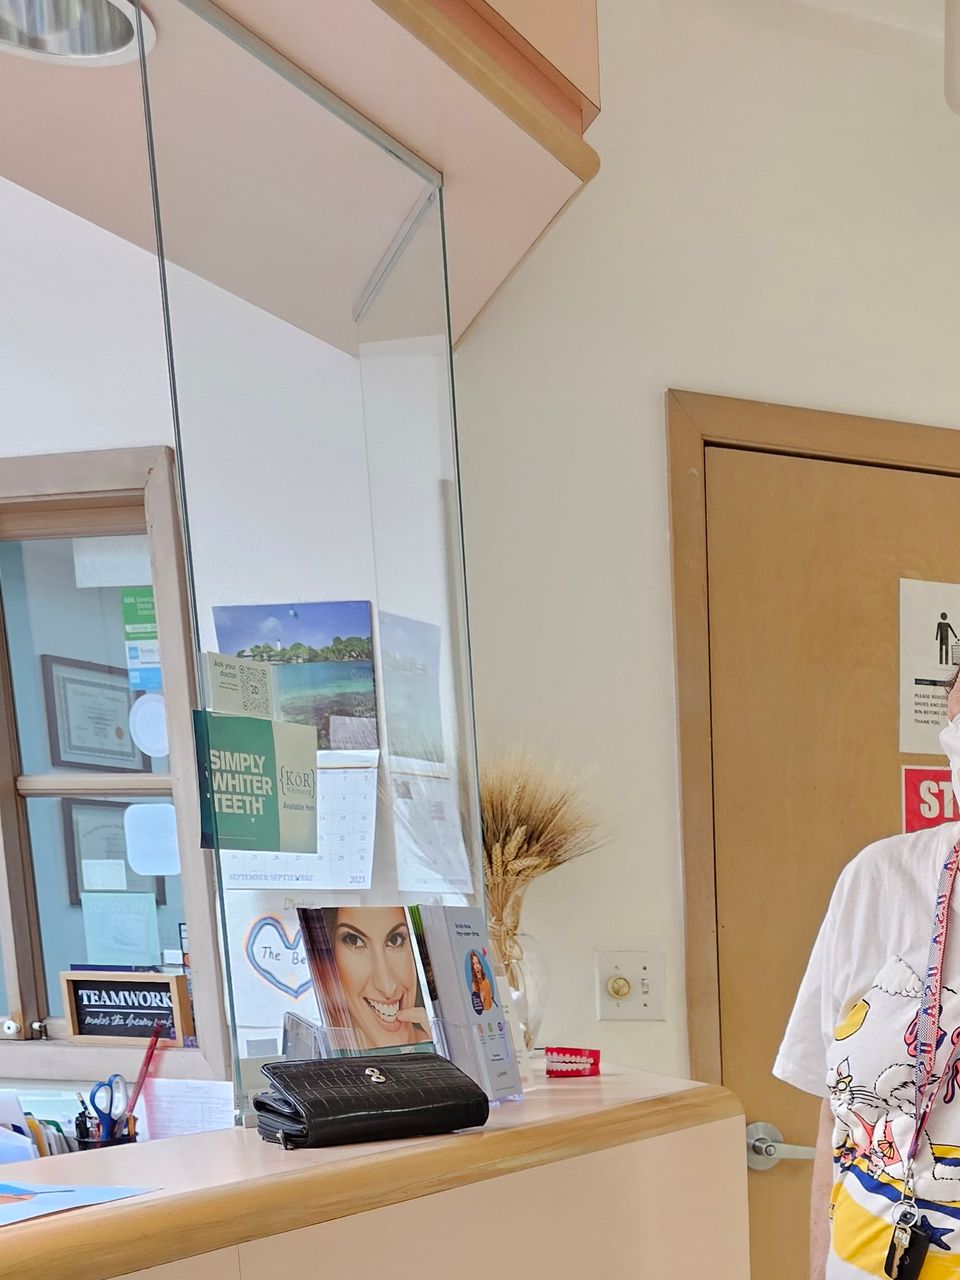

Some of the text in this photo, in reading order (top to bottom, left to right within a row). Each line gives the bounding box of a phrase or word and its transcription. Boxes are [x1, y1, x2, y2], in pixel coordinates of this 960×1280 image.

[210, 749, 266, 774] SIMPLY
[212, 771, 273, 796] WHITER
[214, 793, 266, 815] TEETH
[261, 946, 281, 962] The
[78, 989, 174, 1008] TEAMWORK
[84, 1012, 109, 1026] makes
[110, 1013, 125, 1026] the
[126, 1013, 153, 1028] dream
